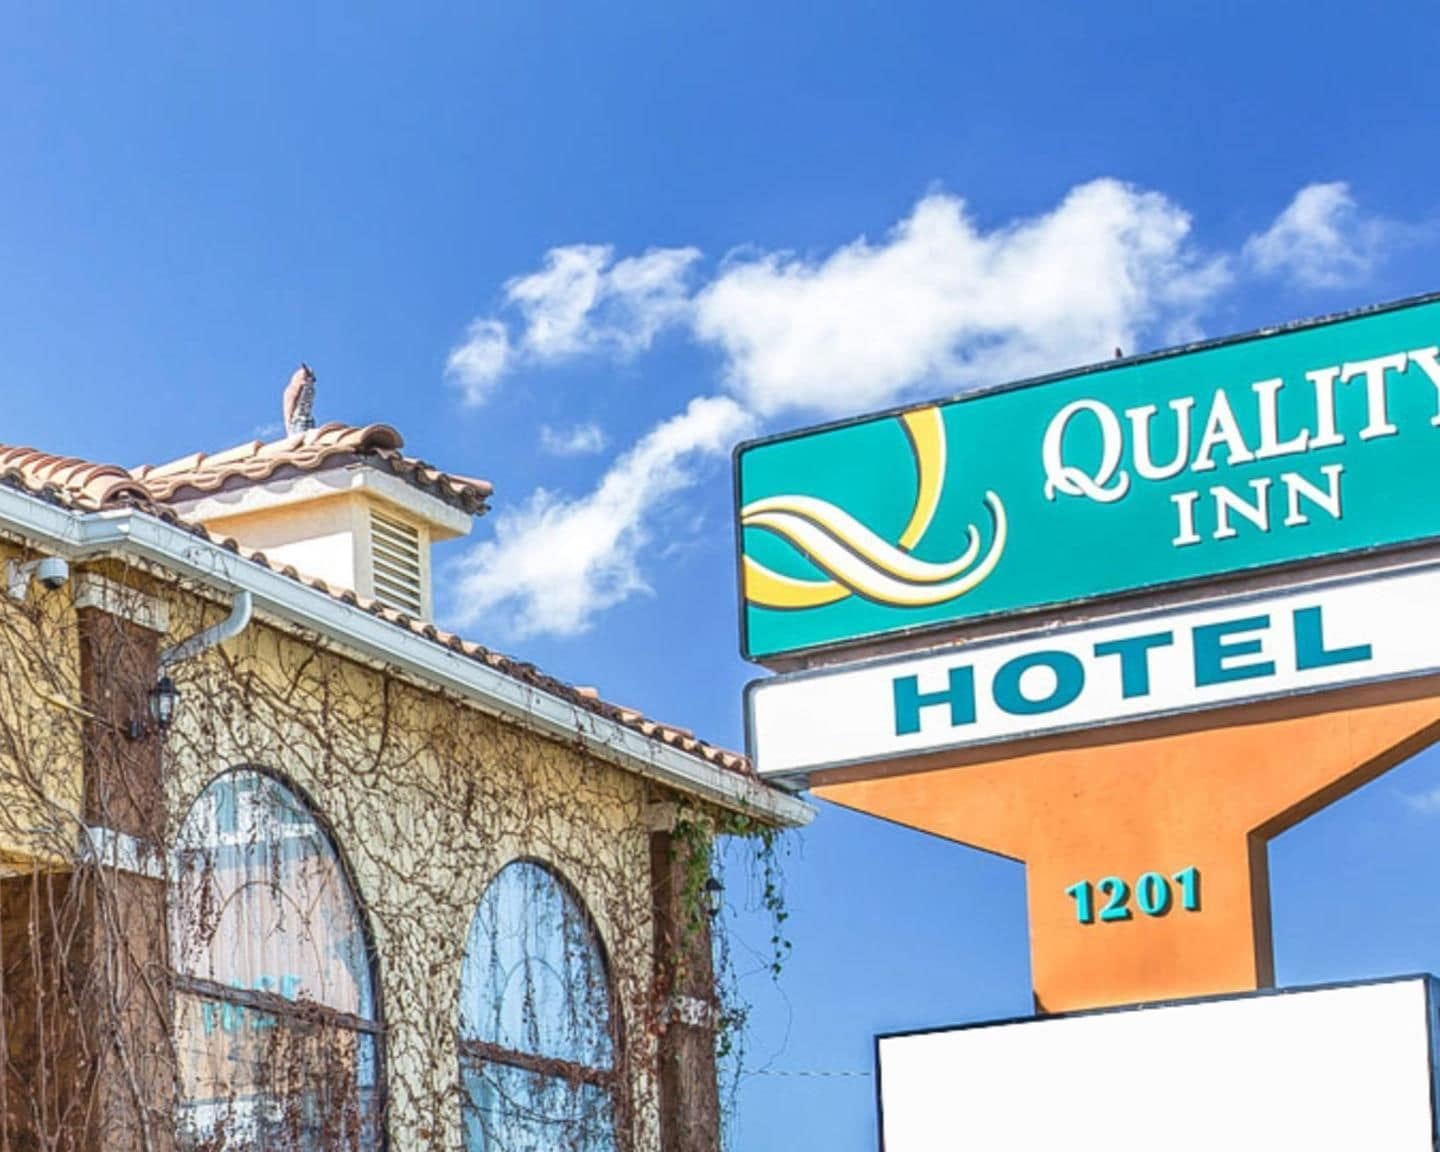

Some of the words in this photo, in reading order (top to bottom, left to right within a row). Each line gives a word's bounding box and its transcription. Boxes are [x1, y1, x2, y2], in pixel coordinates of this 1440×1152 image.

[1170, 464, 1344, 548] INN
[892, 604, 1373, 737] HOTEL
[1064, 865, 1202, 925] 1201
